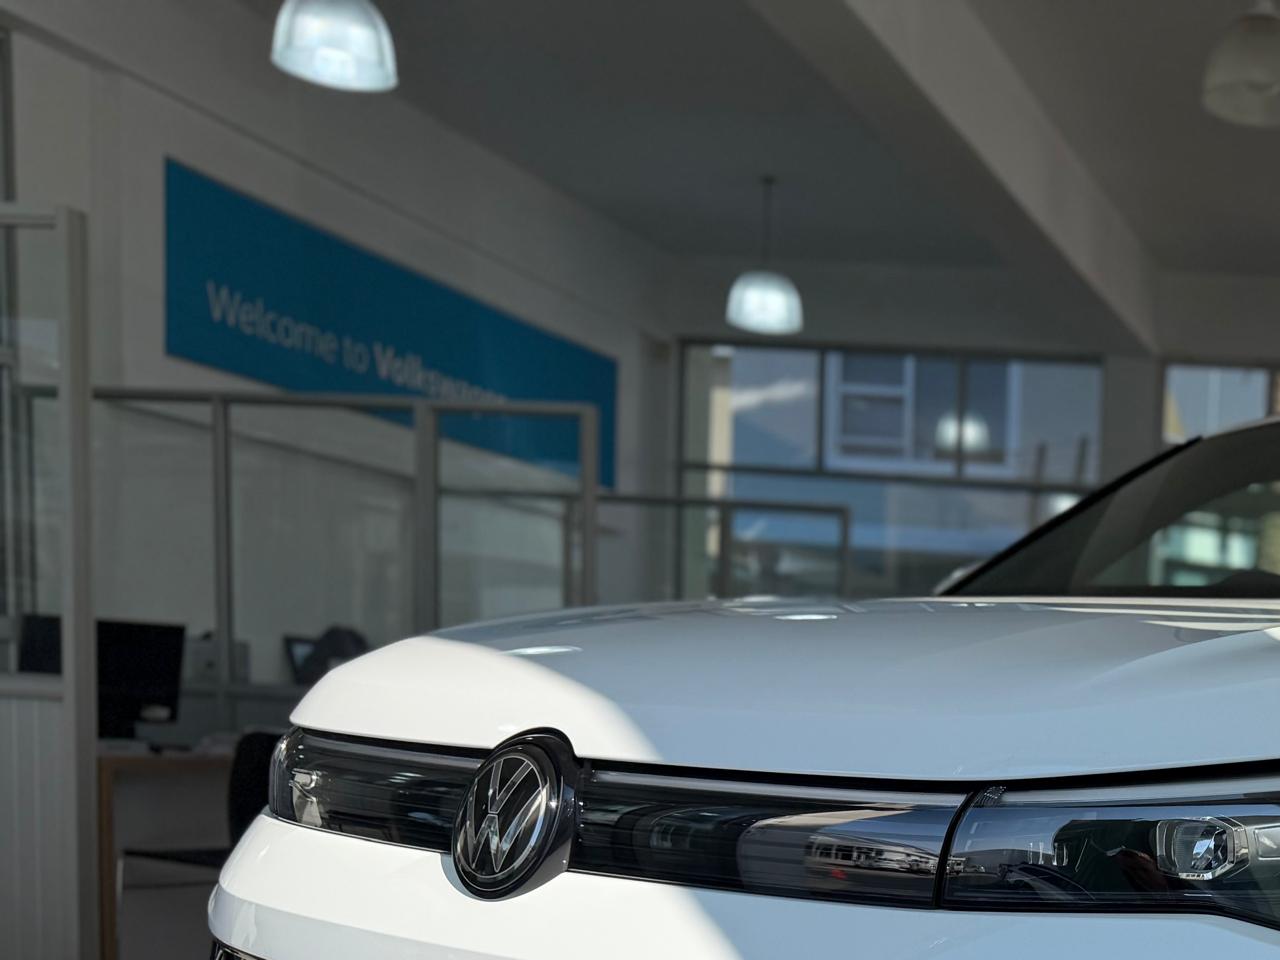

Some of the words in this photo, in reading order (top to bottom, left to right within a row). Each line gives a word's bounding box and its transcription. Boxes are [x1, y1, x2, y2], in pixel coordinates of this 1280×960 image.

[207, 279, 337, 363] Welcome
[344, 336, 370, 374] to
[373, 341, 508, 400] Volkswa
